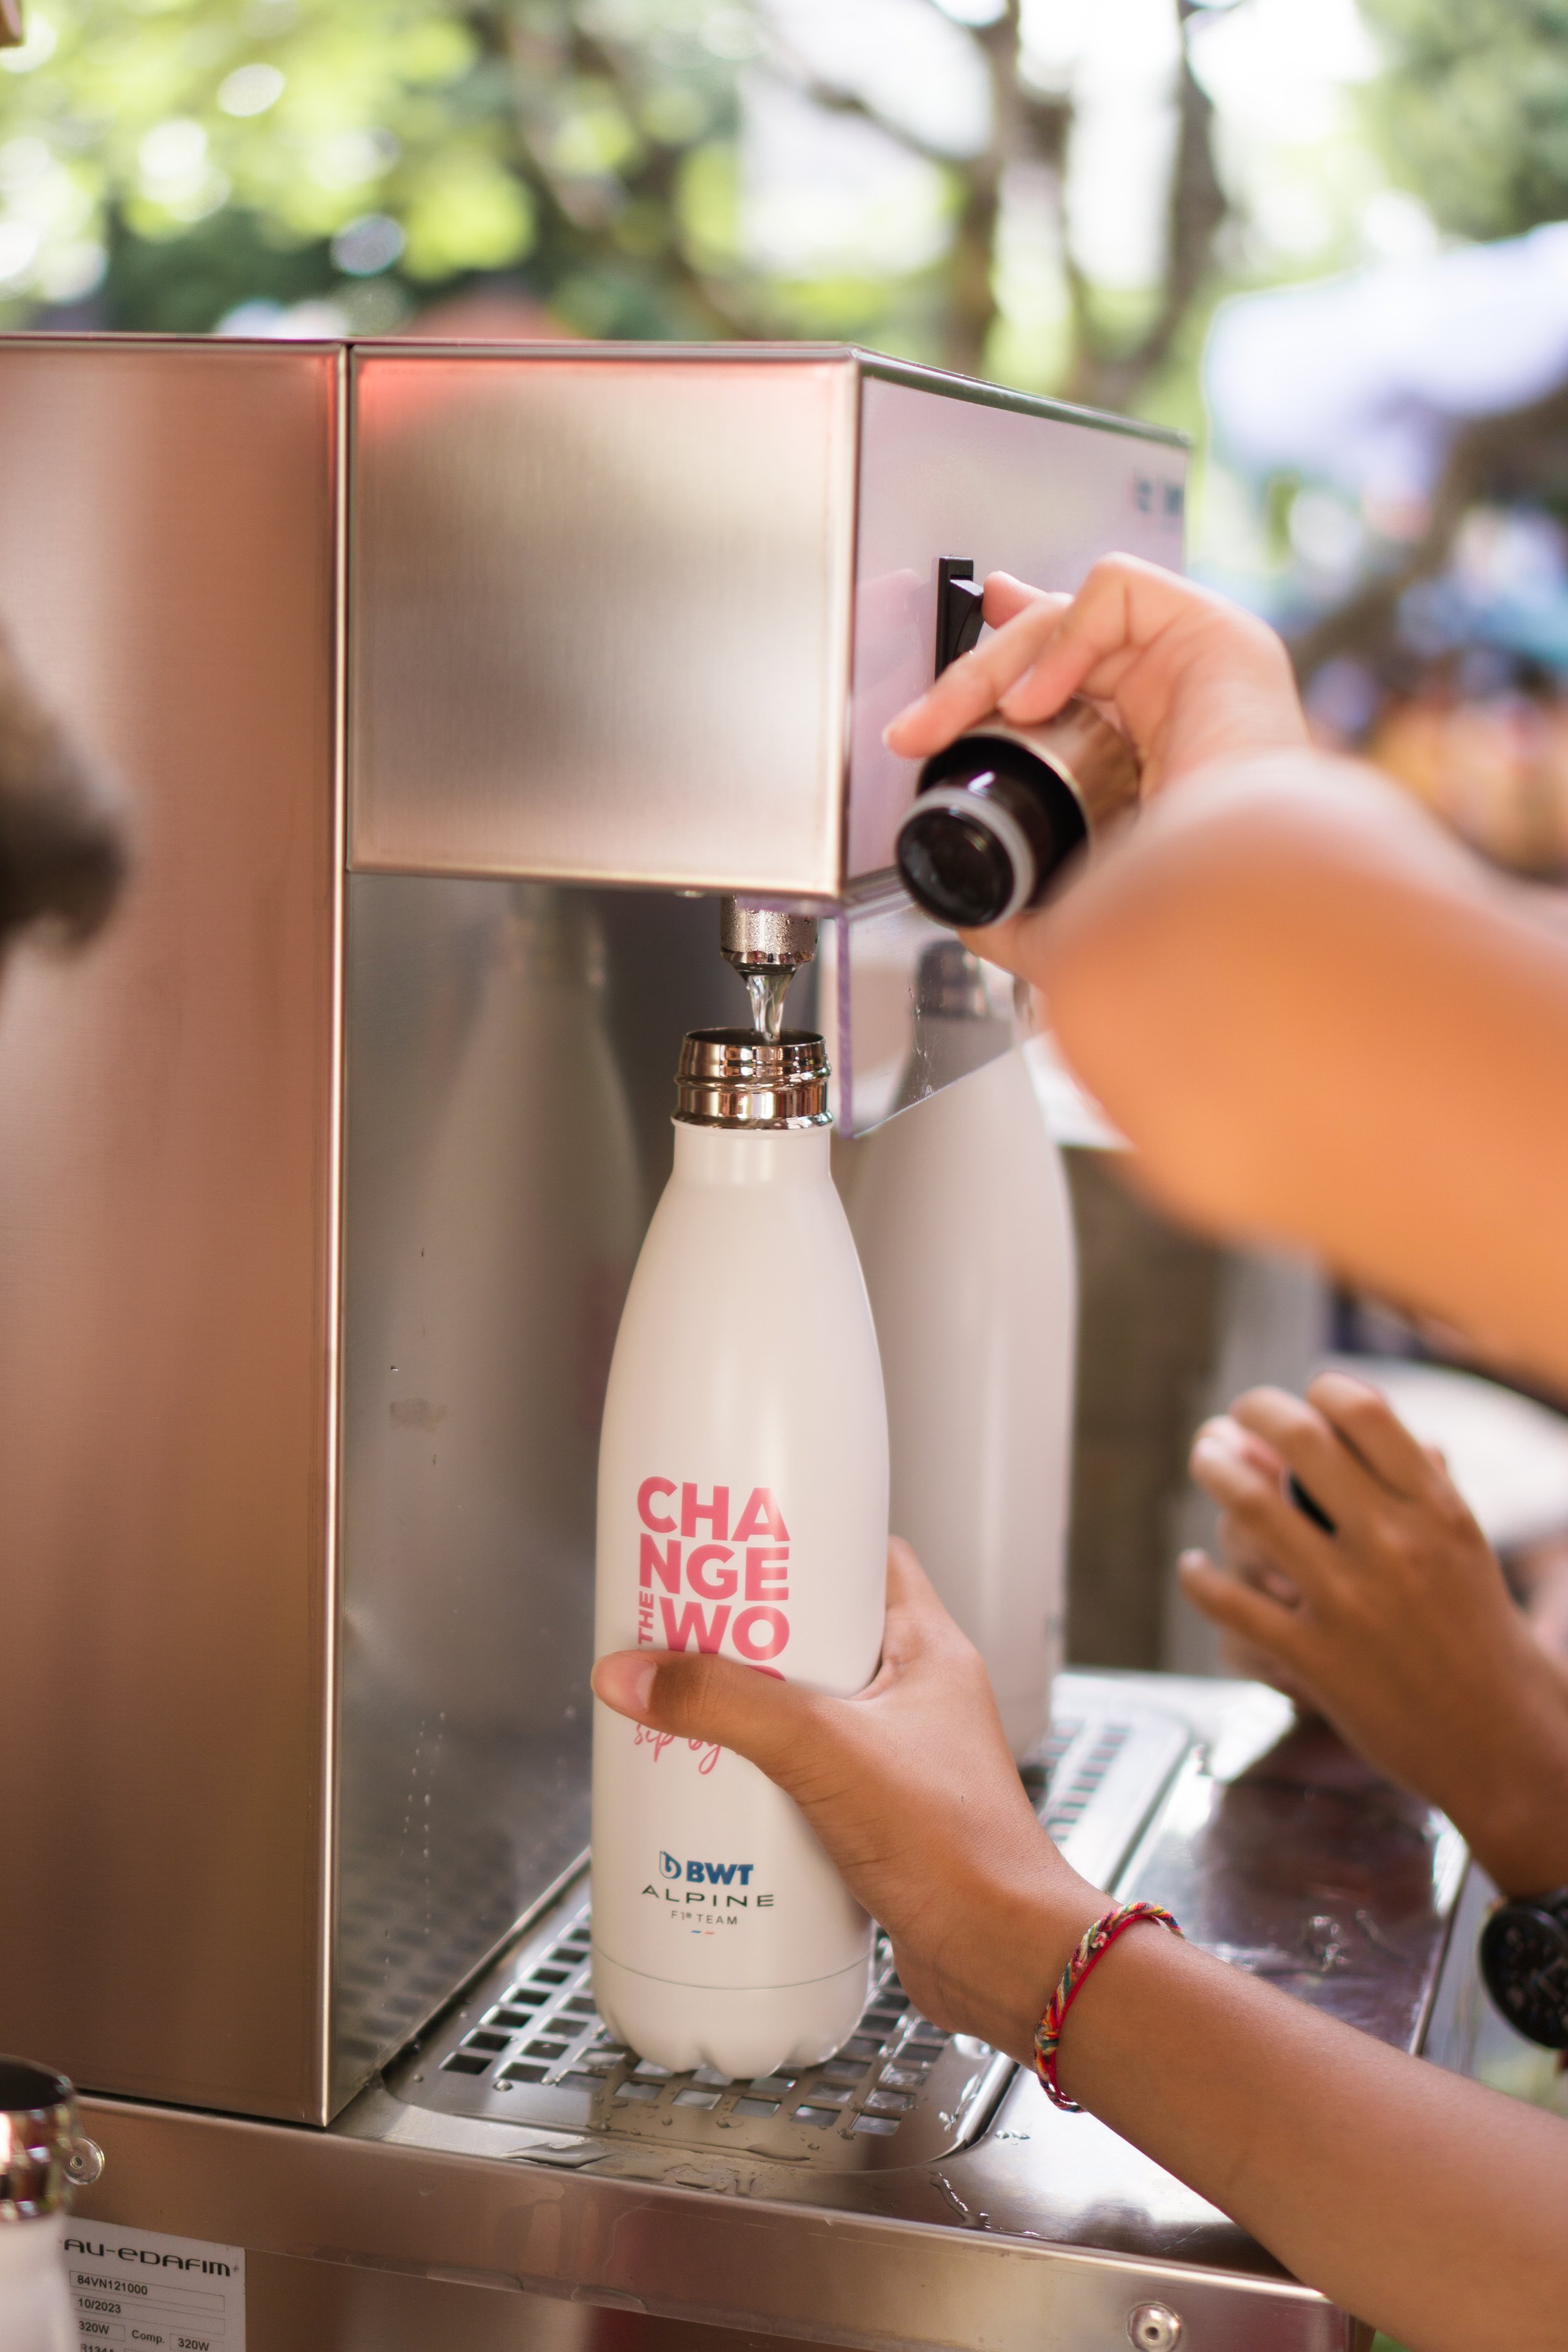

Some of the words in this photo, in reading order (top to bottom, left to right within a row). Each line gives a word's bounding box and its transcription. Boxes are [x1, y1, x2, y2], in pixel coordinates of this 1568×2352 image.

[637, 1476, 791, 1542] CHA
[639, 1532, 790, 1601] NGE
[638, 1590, 654, 1645] THE
[659, 1596, 790, 1661] WO
[686, 1860, 754, 1885] BWT
[642, 1884, 774, 1907] ALPINE
[696, 1914, 738, 1925] TEAM
[77, 2275, 148, 2295] 84VN121000
[78, 2298, 121, 2313] 10/2023
[78, 2321, 110, 2334] 320W
[131, 2329, 165, 2344] Comp.
[177, 2338, 210, 2351] 320W
